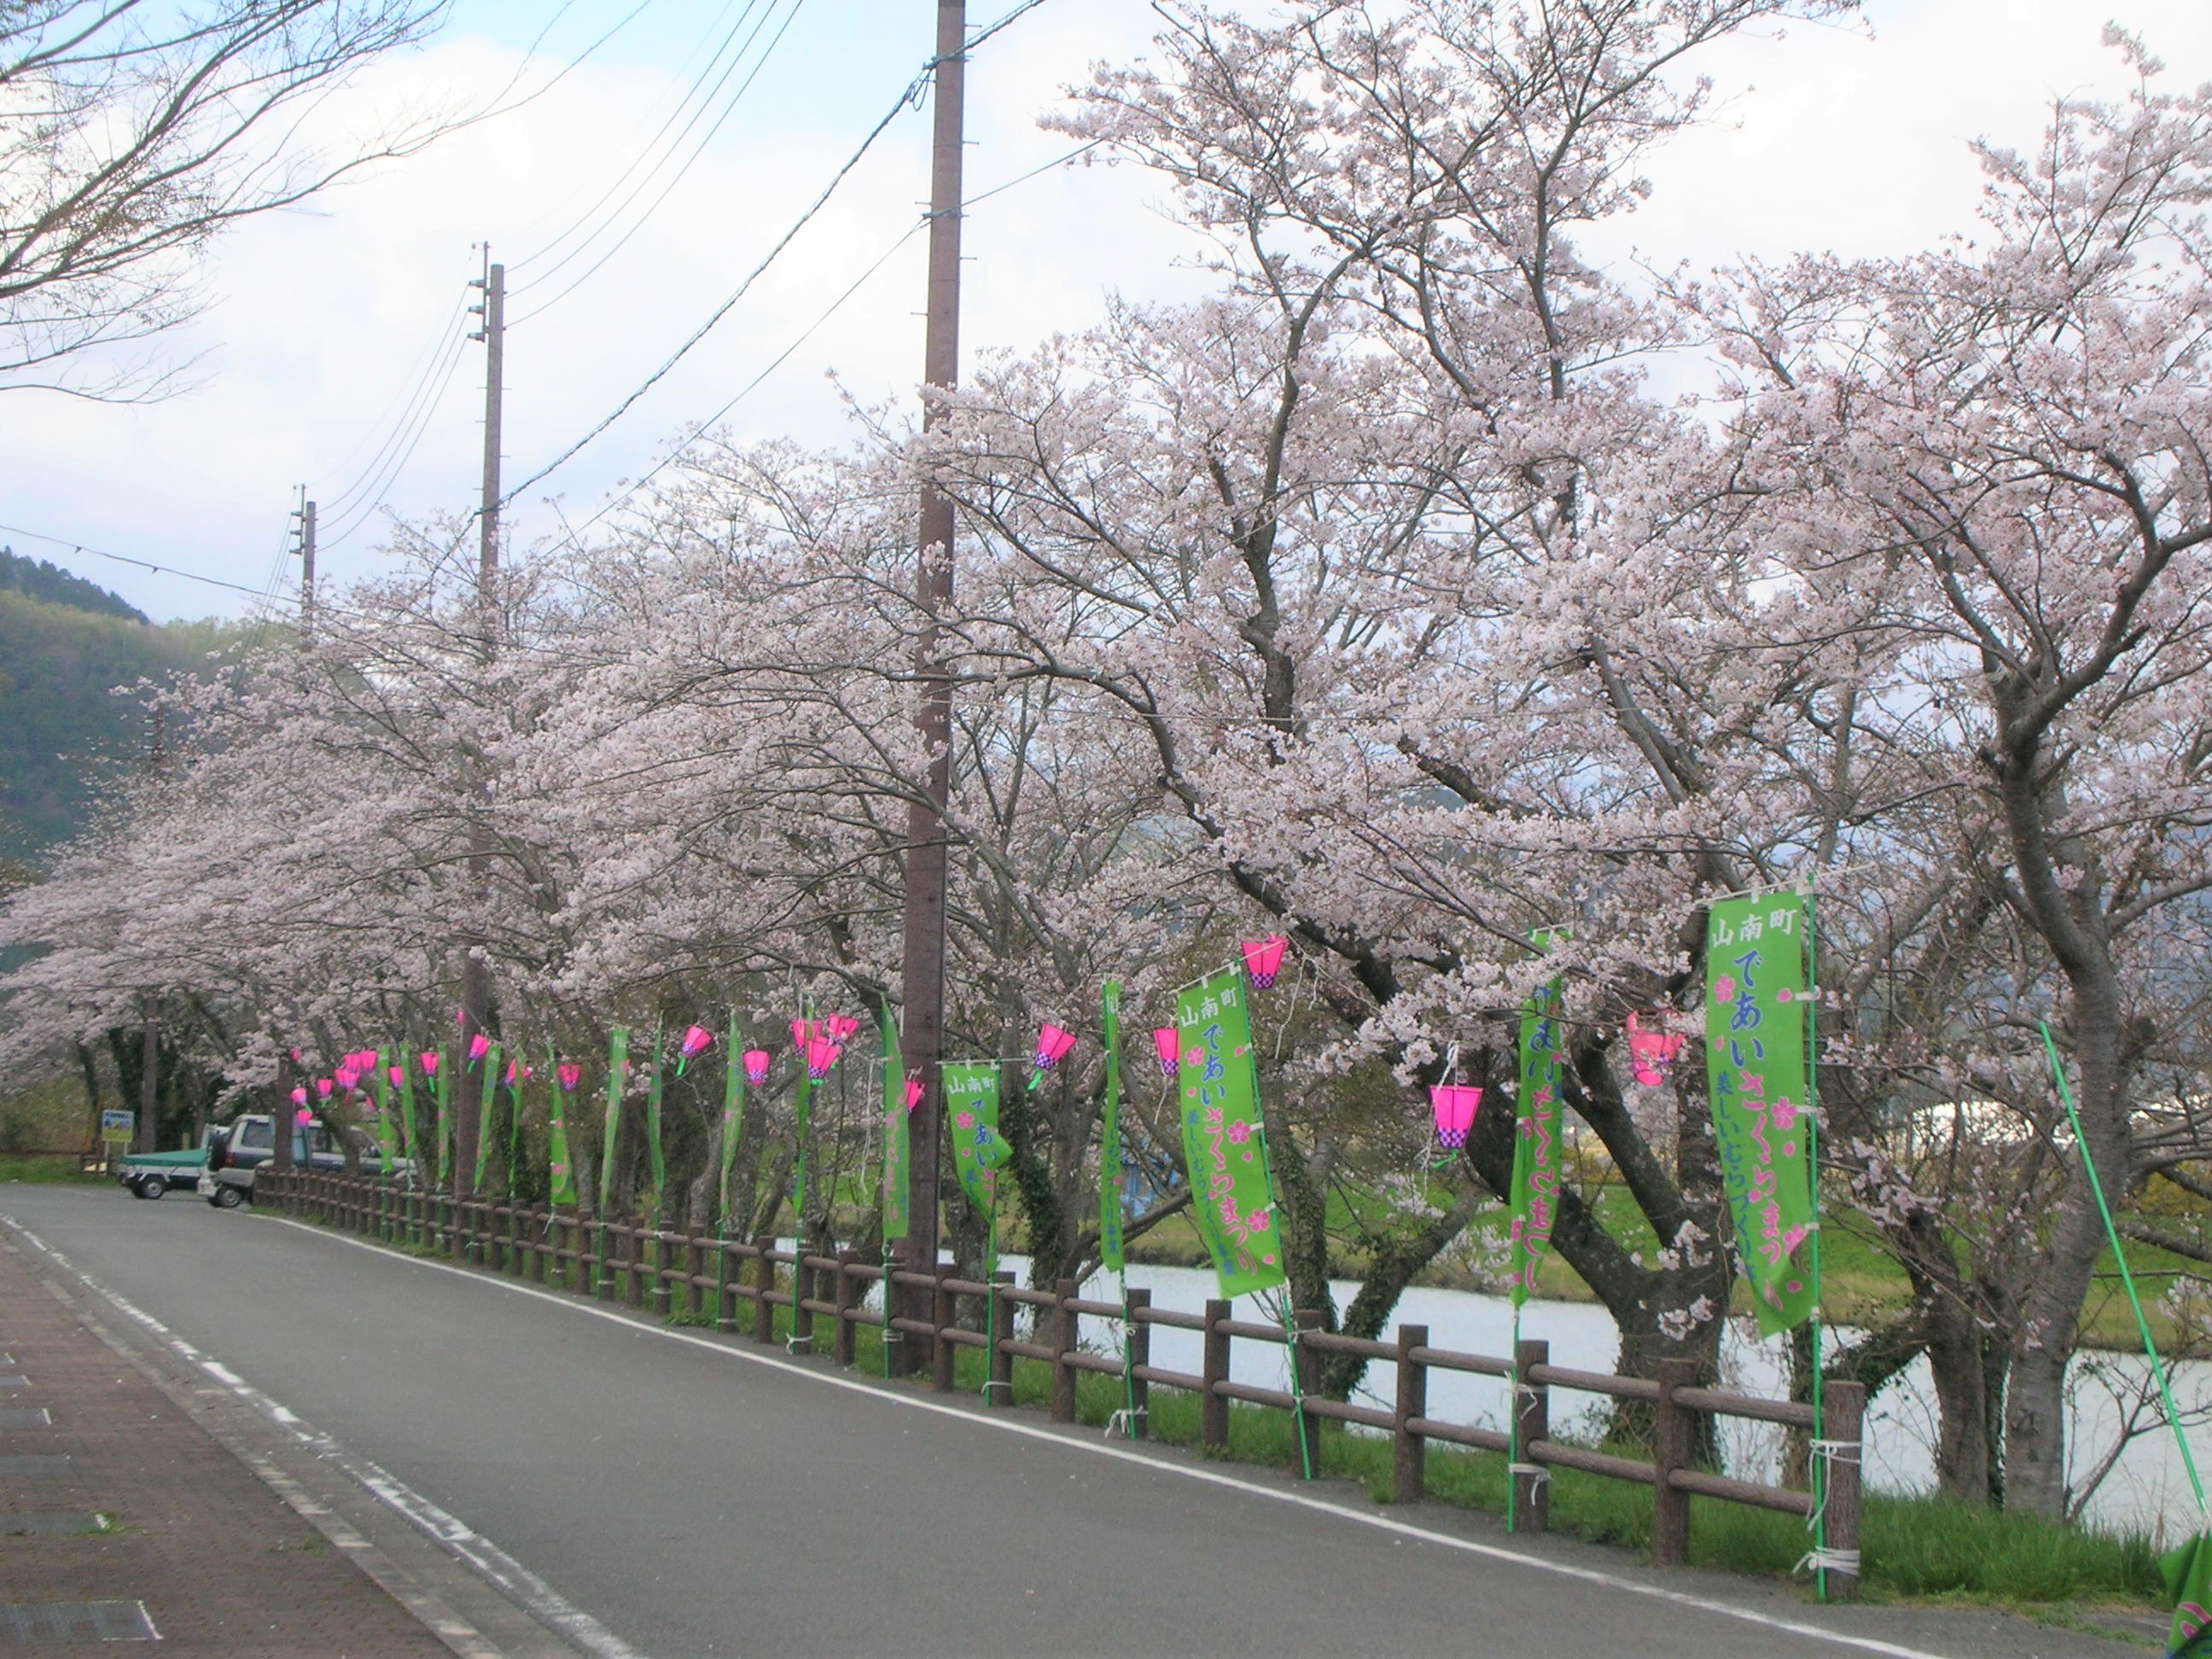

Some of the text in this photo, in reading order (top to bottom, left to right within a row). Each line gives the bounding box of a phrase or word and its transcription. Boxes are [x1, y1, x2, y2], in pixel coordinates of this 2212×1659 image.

[1713, 909, 1797, 947] 山南町
[1180, 987, 1237, 1027] 山南町
[948, 1075, 996, 1094] 山南町
